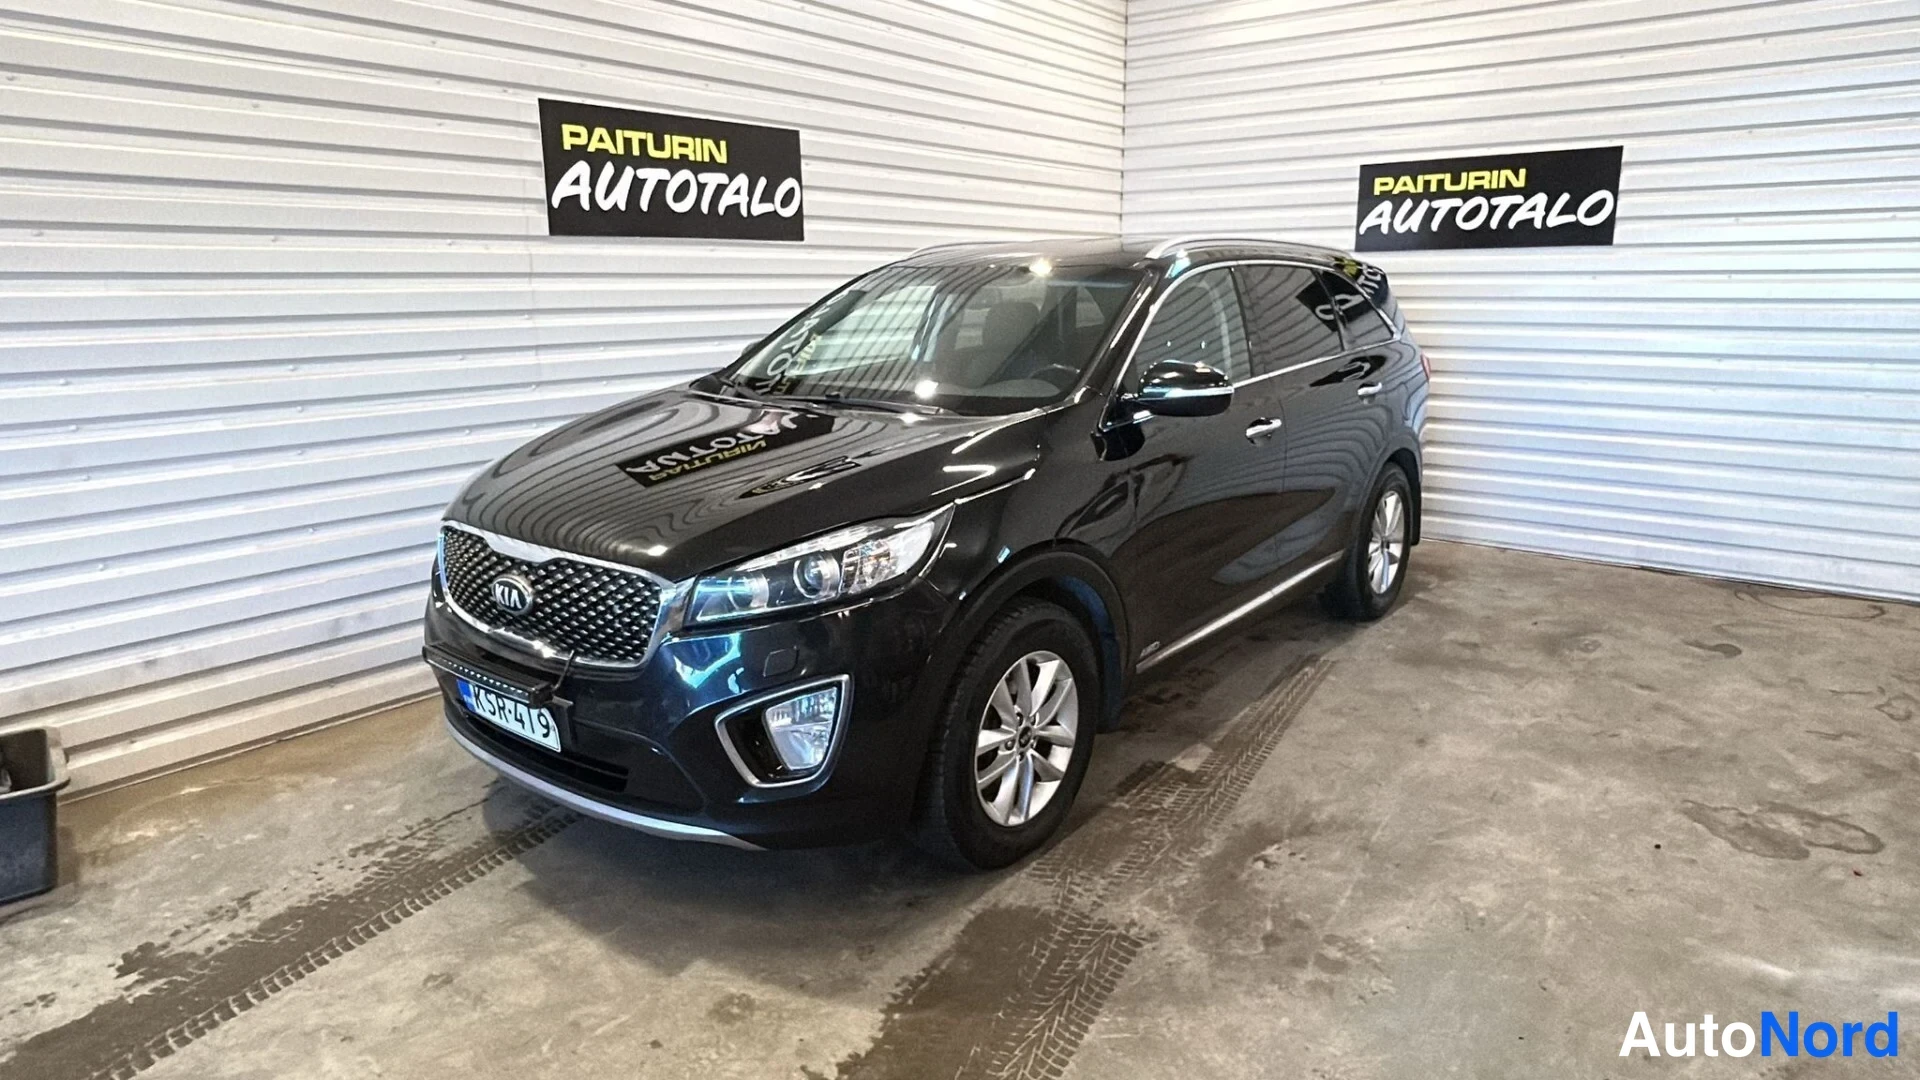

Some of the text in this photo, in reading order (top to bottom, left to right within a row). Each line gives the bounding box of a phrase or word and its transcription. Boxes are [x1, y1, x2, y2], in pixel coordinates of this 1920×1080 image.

[561, 124, 727, 164] PAITURIN
[551, 160, 801, 218] AUTOTALO
[1374, 168, 1526, 195] PAITURIN
[1359, 189, 1614, 235] AUTOTALO
[495, 584, 522, 609] KIA
[473, 685, 551, 738] KSR-419
